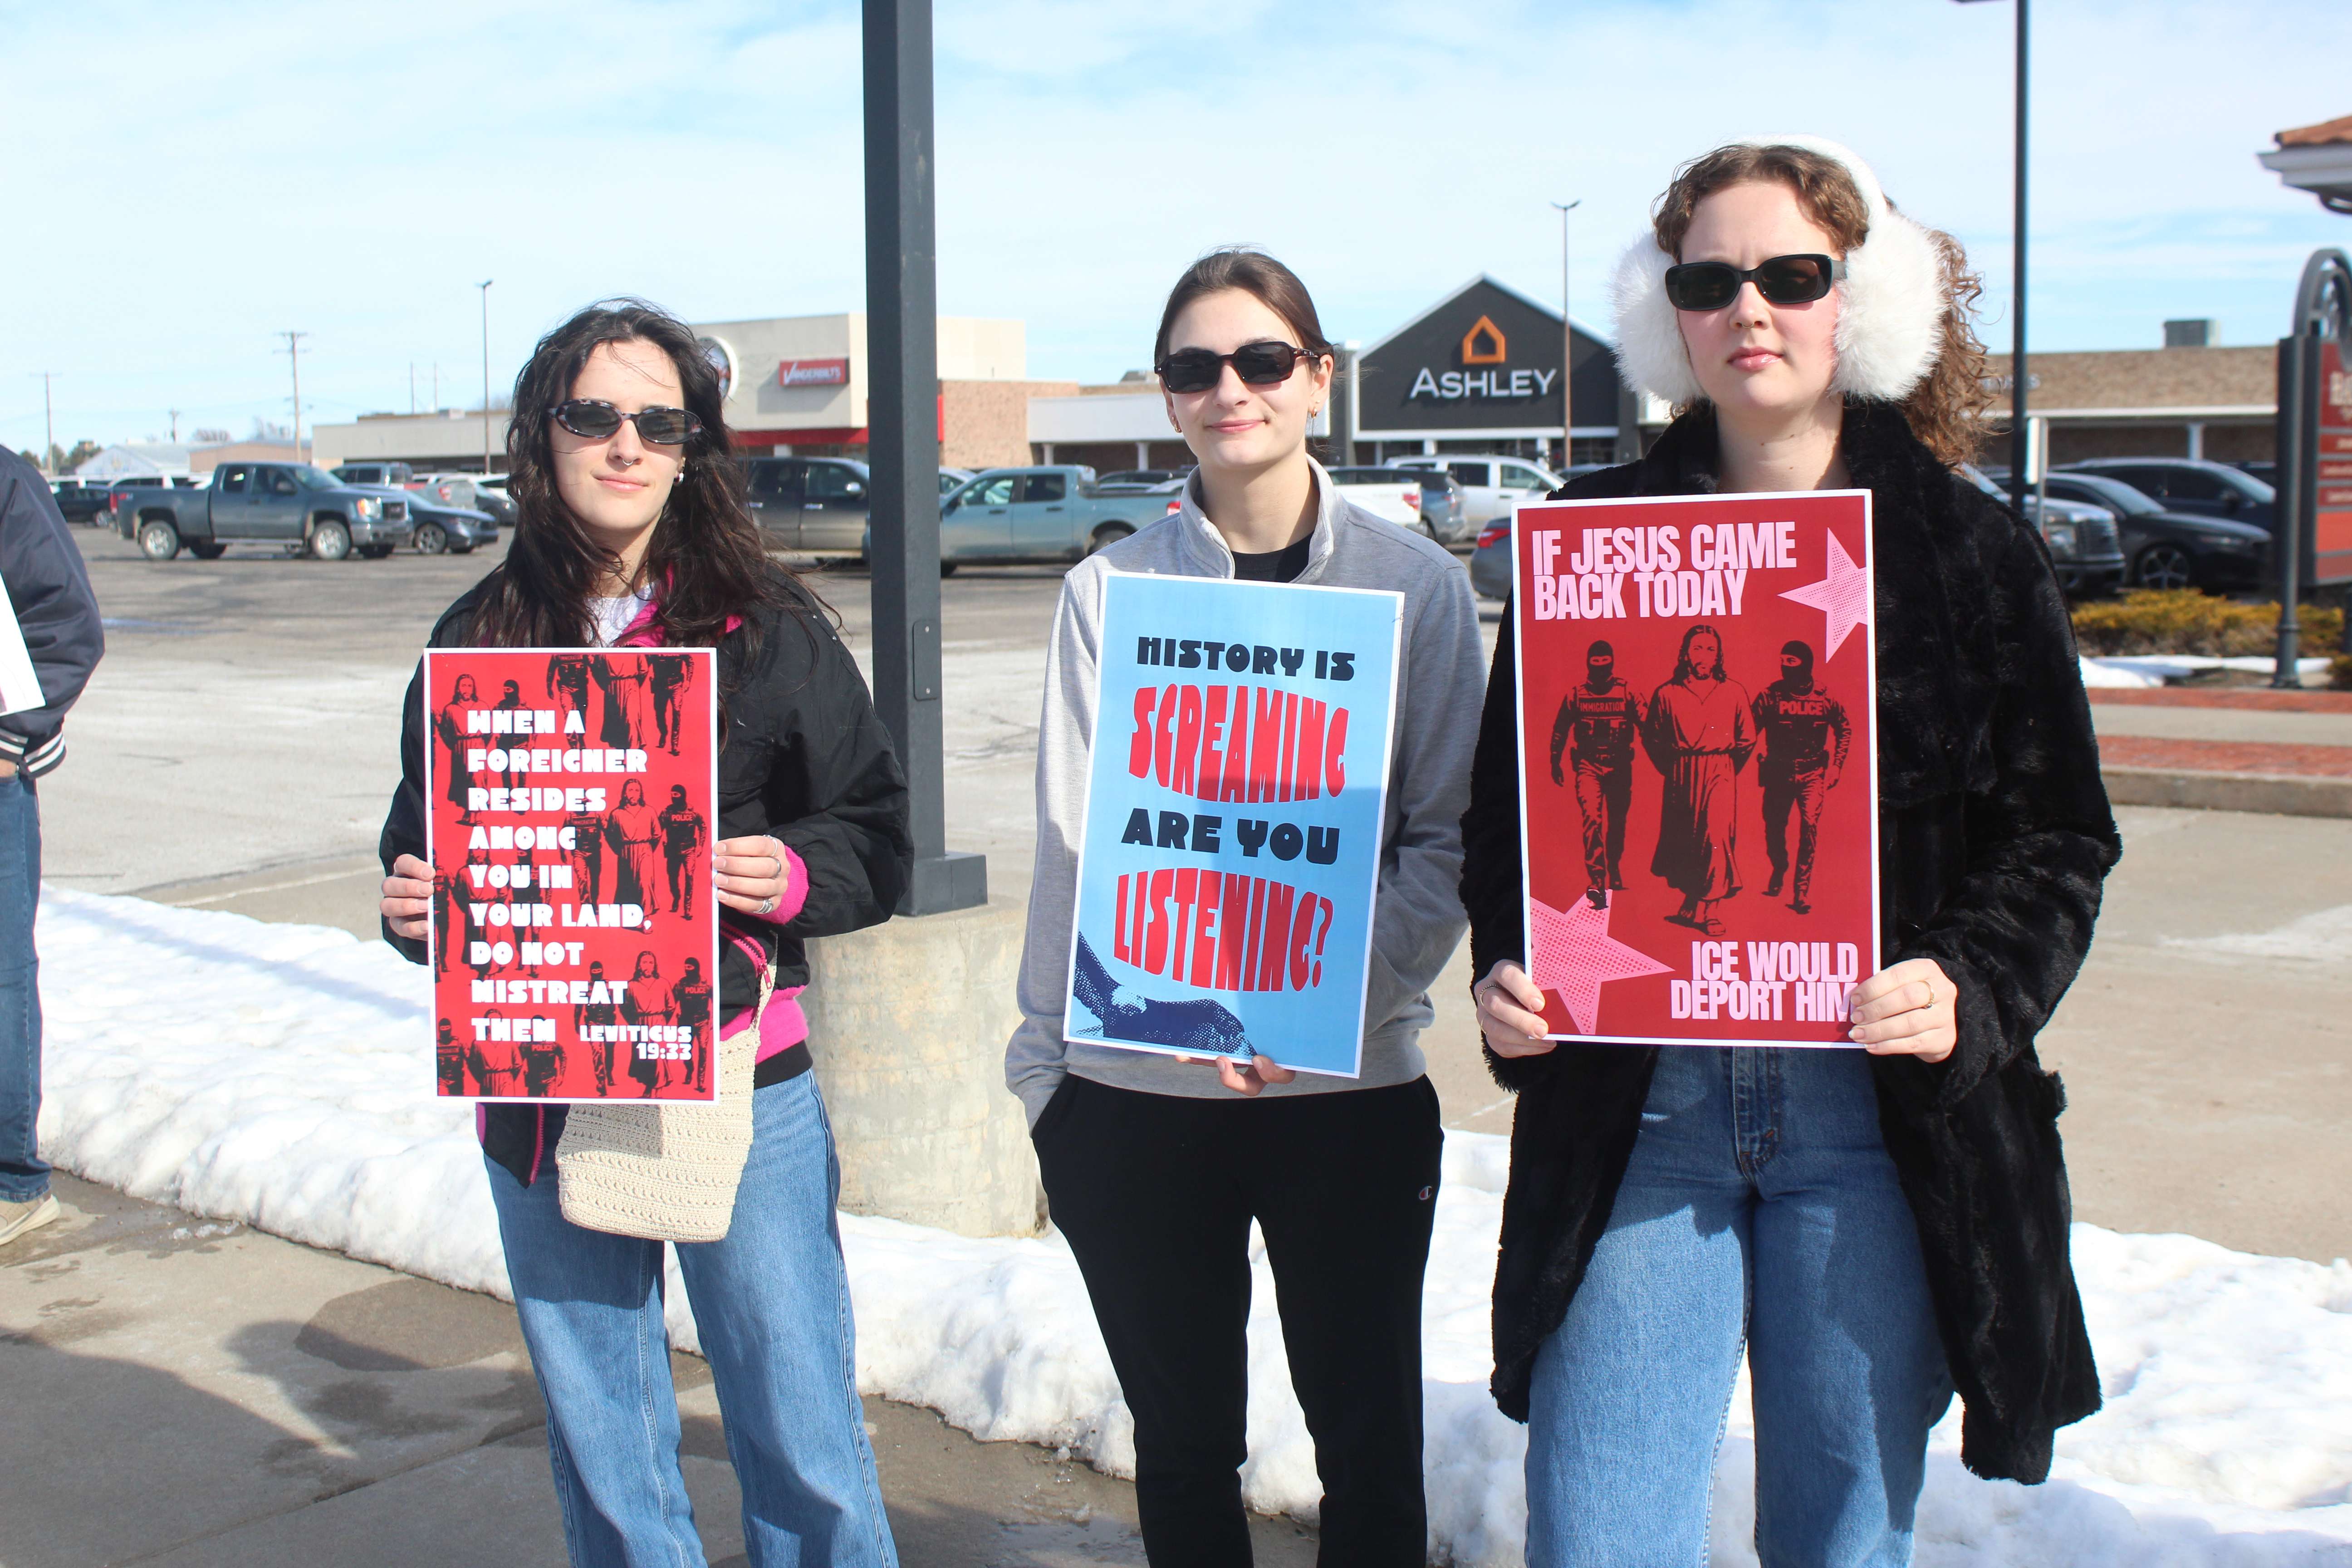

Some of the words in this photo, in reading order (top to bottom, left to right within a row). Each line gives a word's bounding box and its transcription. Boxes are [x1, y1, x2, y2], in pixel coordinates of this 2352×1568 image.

[1410, 367, 1557, 399] ASHLEY
[1532, 530, 1561, 576] IF
[1571, 524, 1681, 575] JESUS
[1691, 521, 1797, 572] CAME
[1535, 573, 1626, 620] BACK
[1634, 569, 1747, 618] TODAY
[1137, 636, 1304, 676] HISTORY
[1315, 650, 1355, 681] IS
[1779, 701, 1823, 715] POLICE
[467, 710, 555, 734] WHEN
[564, 710, 586, 734] A
[1129, 683, 1349, 803] SCREAMING
[467, 749, 647, 773] FOREIGNER
[468, 787, 606, 811] RESIDES
[469, 826, 576, 850] AMONG
[1121, 808, 1222, 853] ARE
[1237, 818, 1340, 865] YOU
[469, 864, 530, 888] YOU
[539, 865, 572, 888] IN
[469, 903, 553, 927] YOUR
[562, 903, 652, 931] LAND,
[1114, 868, 1333, 991] LISTENING?
[470, 941, 514, 965] DO
[521, 942, 584, 965] NOT
[1692, 941, 1739, 981] ICE
[1747, 941, 1859, 983] WOULD
[471, 980, 628, 1004] MISTREAT
[1671, 980, 1787, 1020] DEPORT
[471, 1018, 556, 1042] THEM
[579, 1025, 692, 1043] LEVITICUS
[636, 1043, 692, 1060] 19:33
